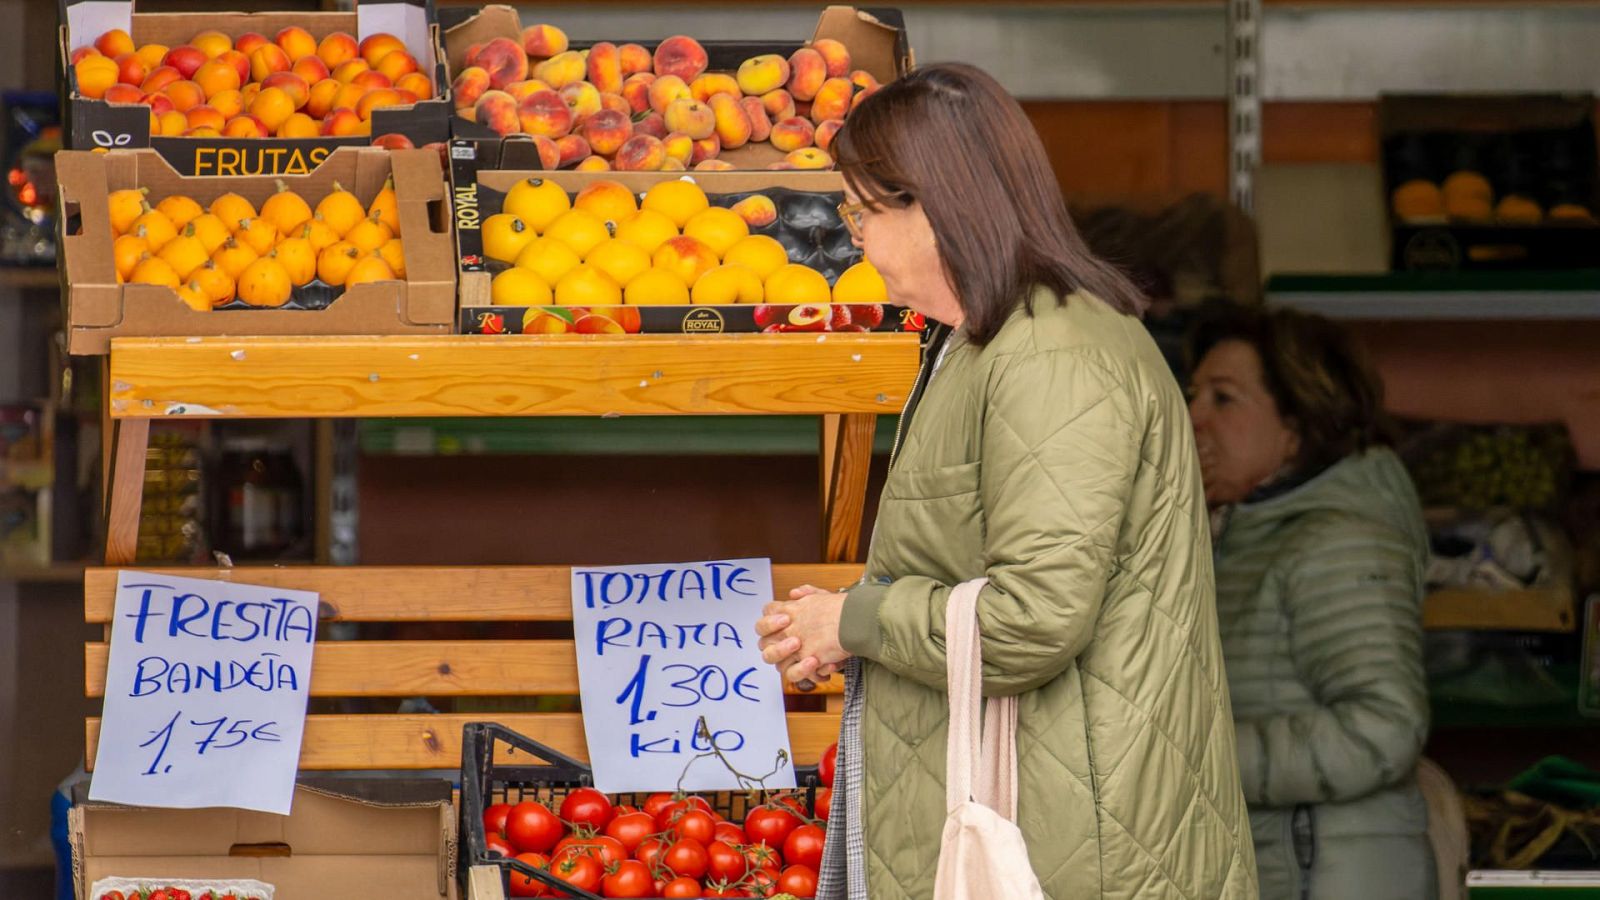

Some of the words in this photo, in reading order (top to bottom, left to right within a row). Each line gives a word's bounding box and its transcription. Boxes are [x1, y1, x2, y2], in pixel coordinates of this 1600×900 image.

[455, 182, 481, 230] ROYAL
[686, 320, 720, 329] ROYAL
[575, 562, 758, 609] TOMATE
[123, 584, 313, 644] FRESITA
[596, 617, 743, 656] RAMA
[128, 652, 298, 697] BANDEJA
